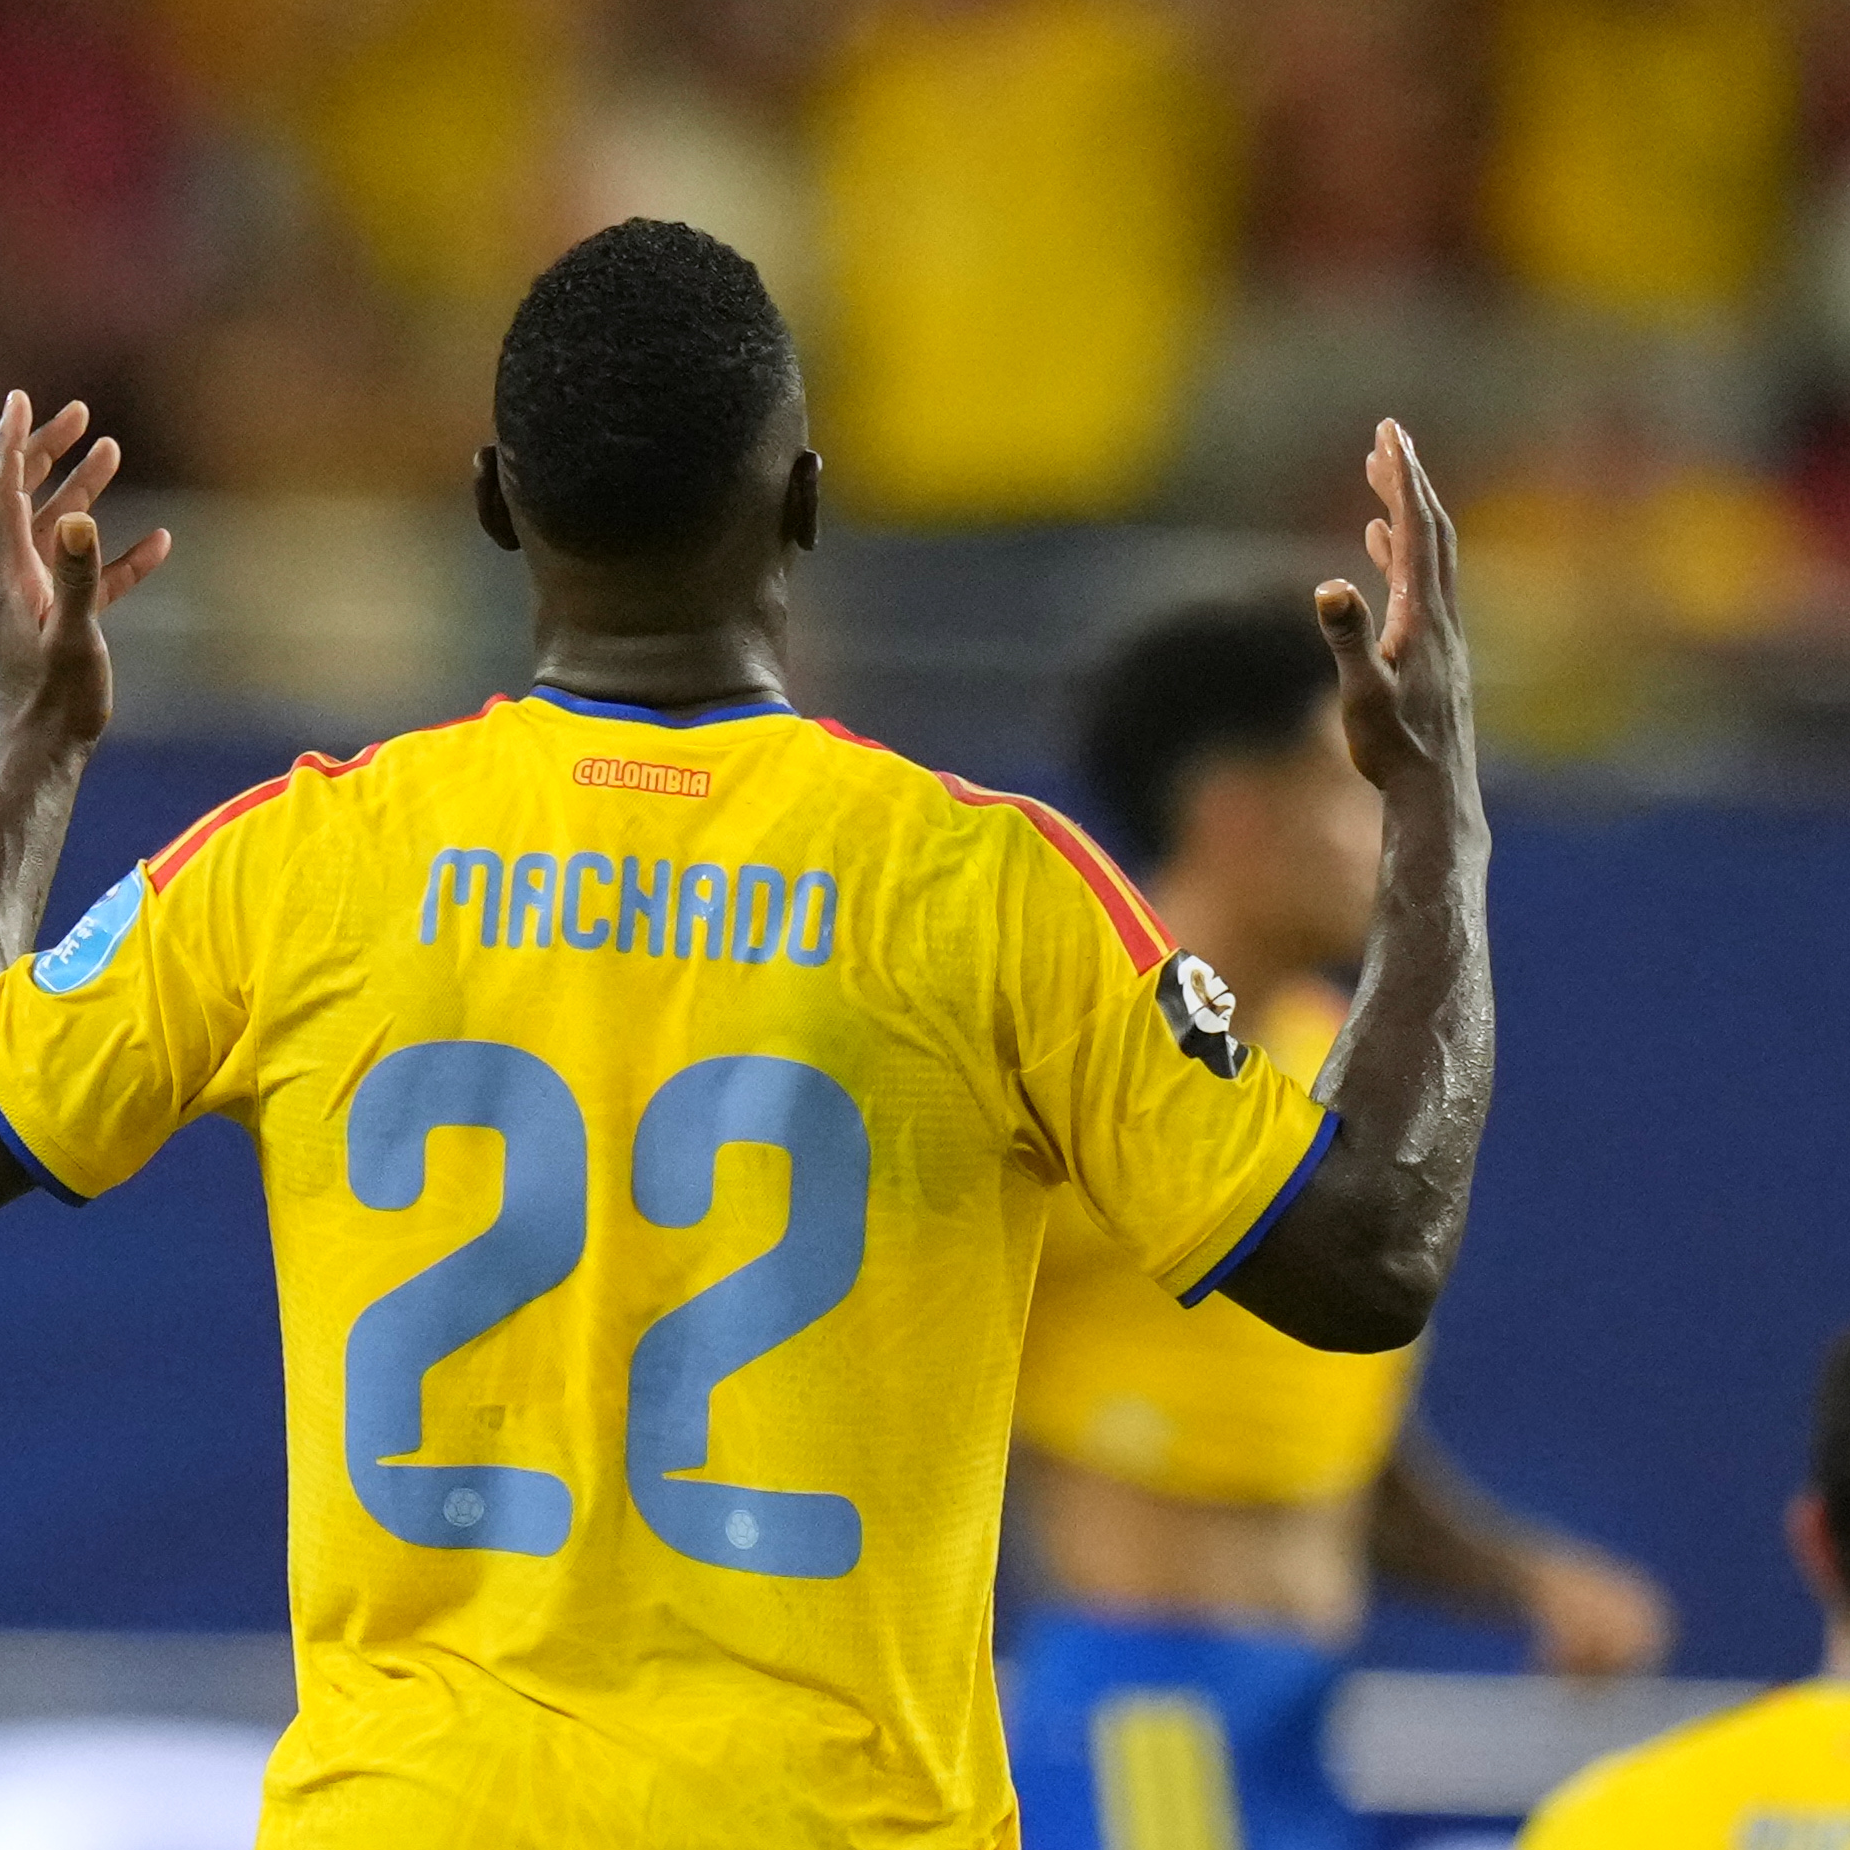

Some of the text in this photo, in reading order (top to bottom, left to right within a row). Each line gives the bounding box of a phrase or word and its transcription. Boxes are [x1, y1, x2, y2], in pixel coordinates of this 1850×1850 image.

[572, 757, 711, 798] COLOMBIA
[419, 847, 839, 968] MACHADO
[346, 1039, 871, 1580] 22
